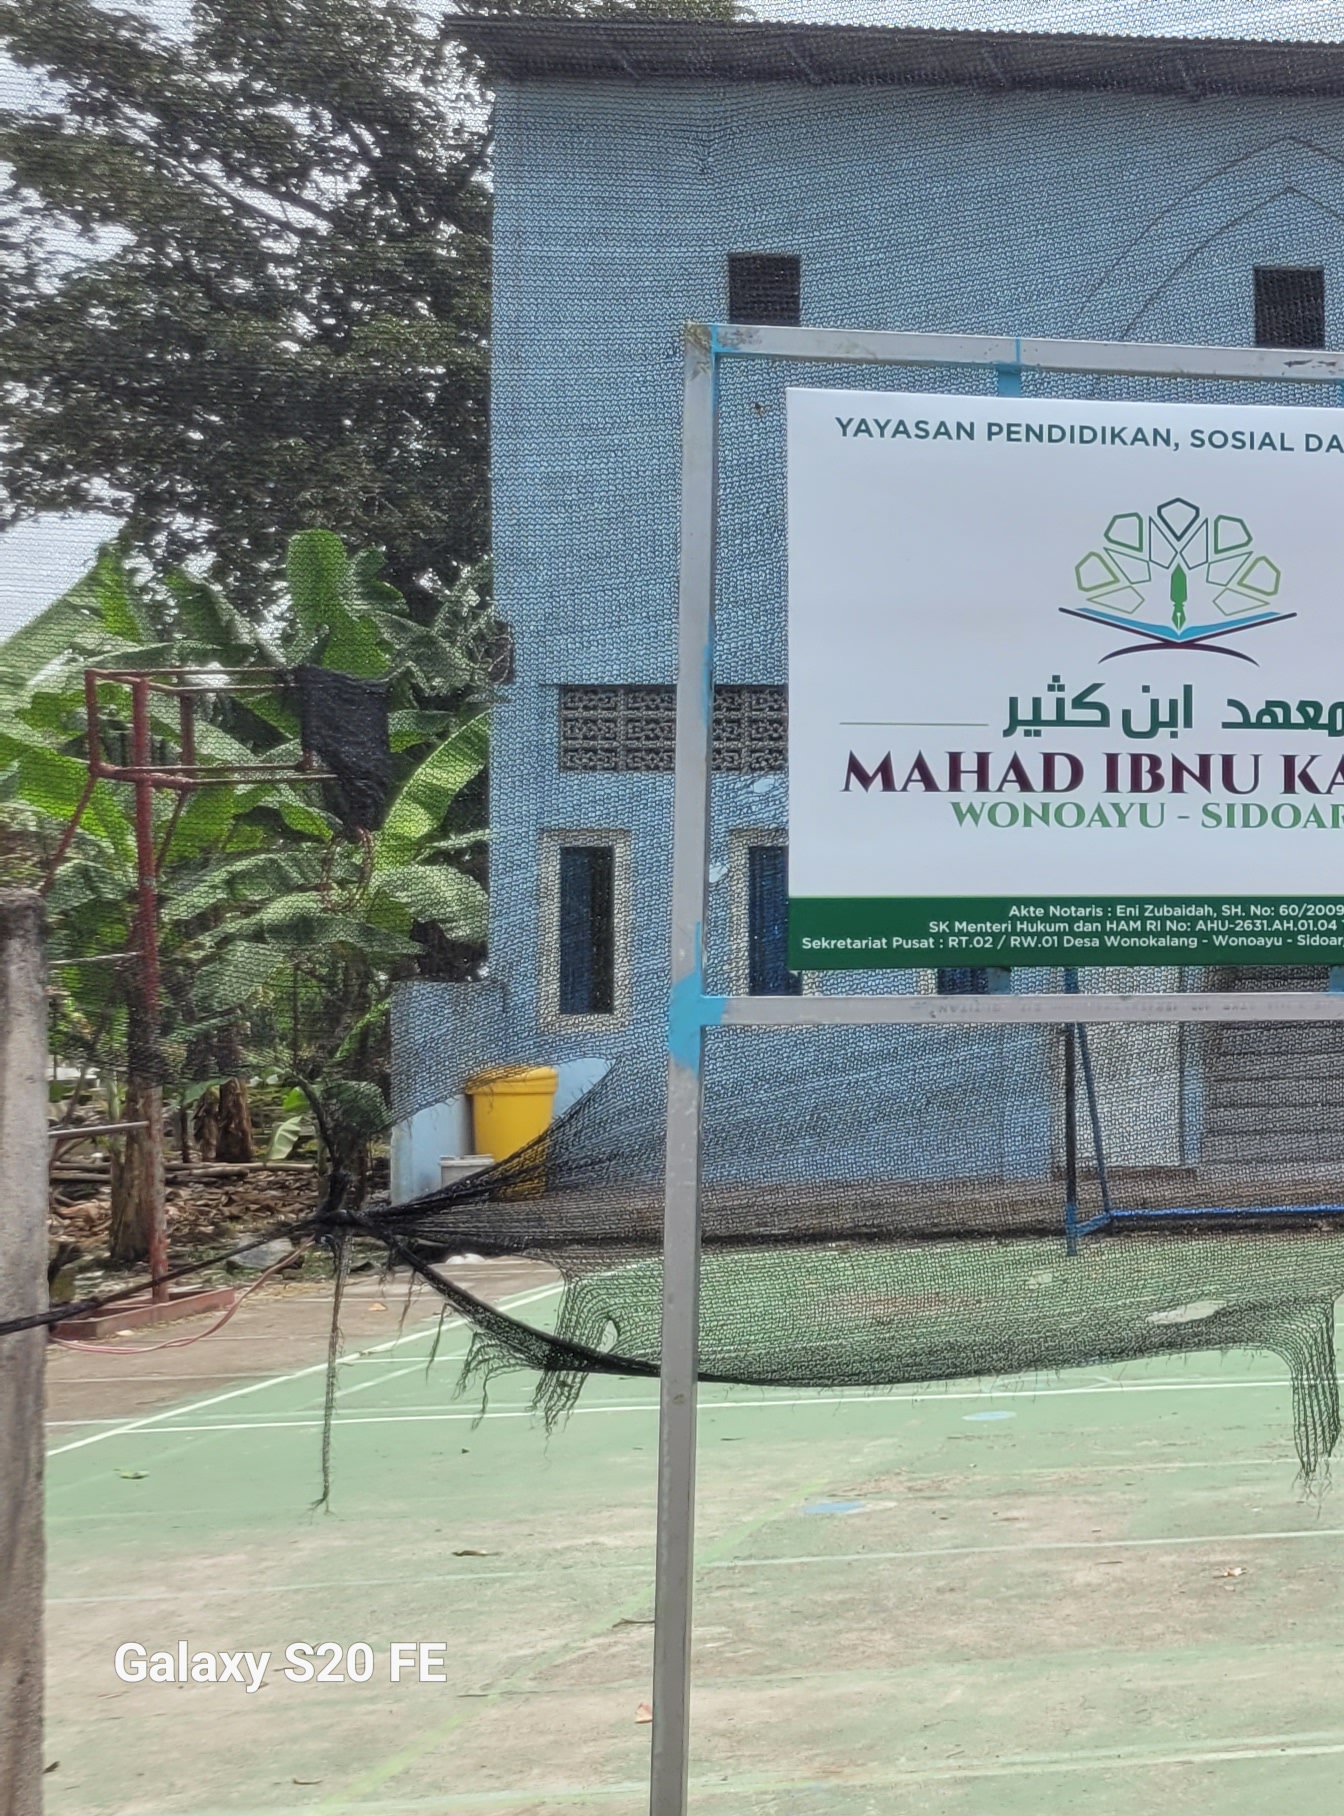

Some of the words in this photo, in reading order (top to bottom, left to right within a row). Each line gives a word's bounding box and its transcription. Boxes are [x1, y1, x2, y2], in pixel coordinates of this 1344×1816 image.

[835, 417, 974, 440] YAYASAN
[987, 422, 1179, 451] PENDIDIKAN,
[1190, 429, 1294, 451] SOSIAL
[1003, 675, 1110, 737] كثير
[1122, 684, 1192, 739] ابن
[842, 750, 1084, 793] MAHAD
[1103, 753, 1262, 794] IBNU
[950, 802, 1165, 828] WONOAYU
[928, 920, 950, 933] SK
[954, 920, 1012, 933] Menteri
[1016, 919, 1069, 933] Hukum
[1073, 919, 1102, 932] dan
[1106, 919, 1142, 932] HAM
[1146, 919, 1161, 932] RI
[1165, 919, 1191, 932] No:
[1195, 919, 1338, 932] AHU-2631.AH.01.04
[1008, 904, 1045, 918] Akte
[1049, 904, 1104, 917] Notaris
[1116, 904, 1140, 917] Eni
[1143, 904, 1217, 919] Zubaidah,
[1221, 904, 1246, 917] SH.
[1250, 904, 1275, 917] No:
[801, 936, 888, 950] Sekretariat
[892, 936, 935, 949] Pusat
[948, 935, 994, 949] RT.02
[1010, 935, 1058, 948] RW.01
[1063, 935, 1100, 948] Desa
[1103, 934, 1198, 949] Wonokalang
[1212, 934, 1283, 949] Wonoayu
